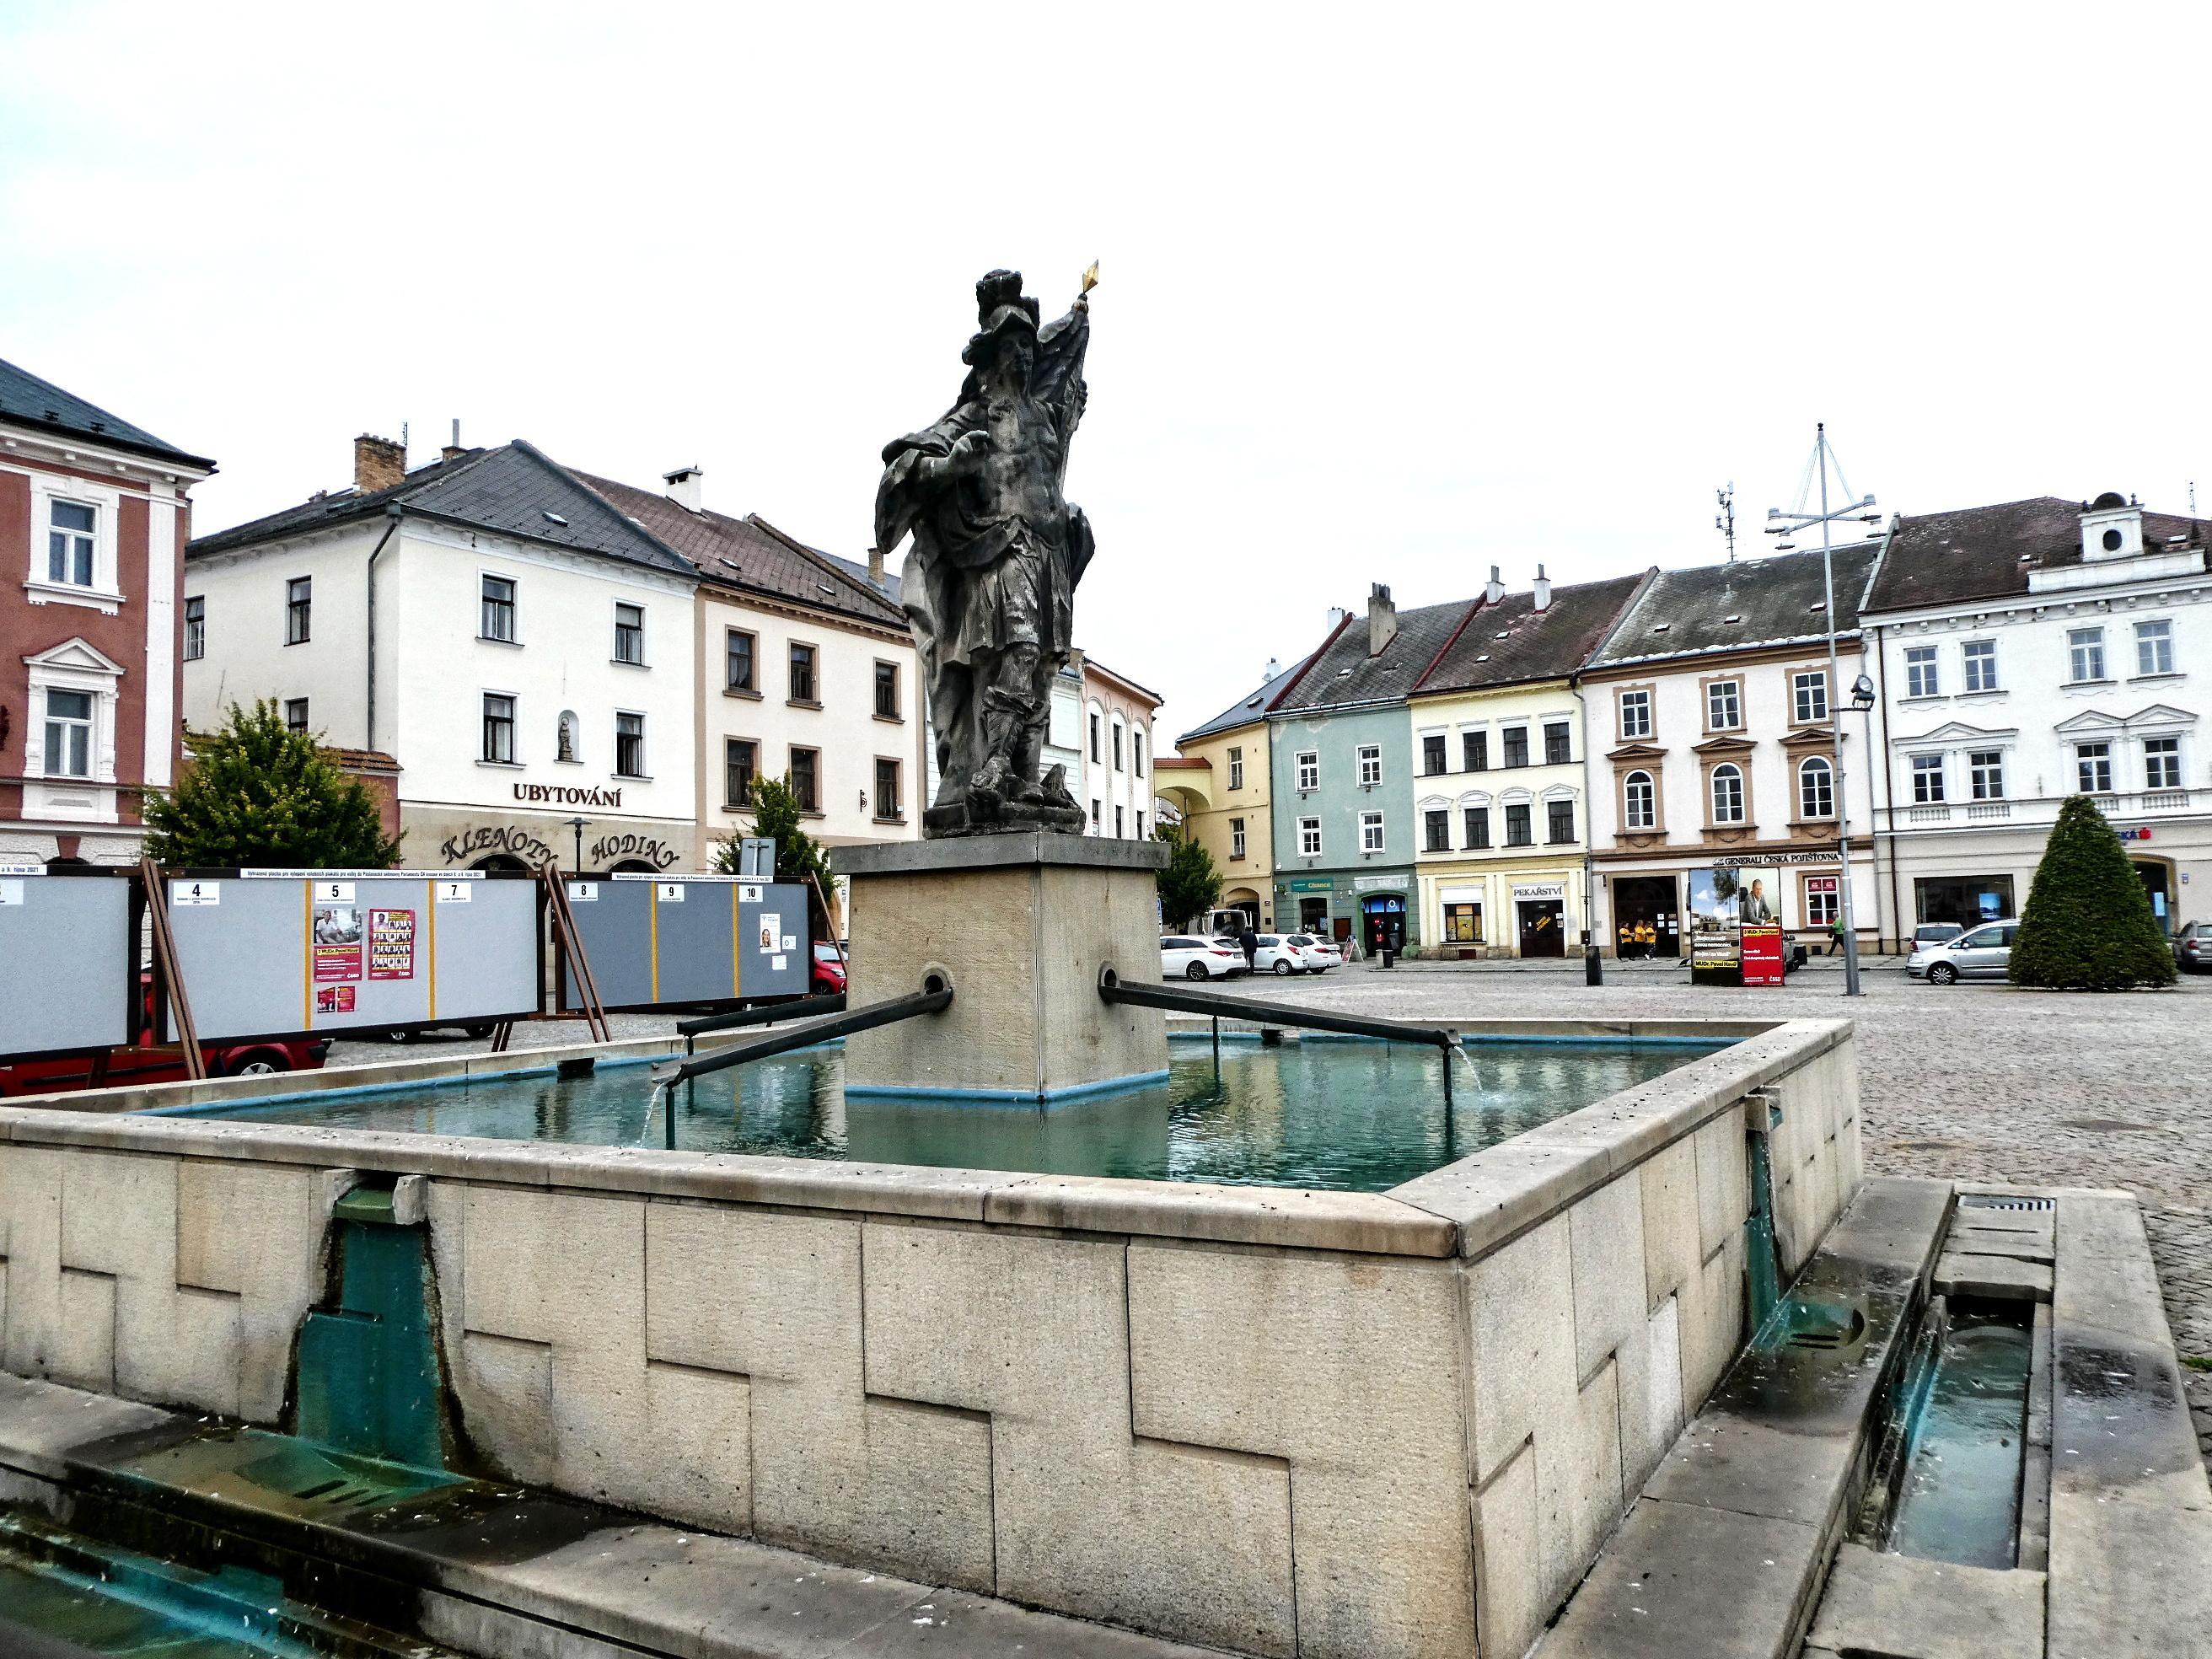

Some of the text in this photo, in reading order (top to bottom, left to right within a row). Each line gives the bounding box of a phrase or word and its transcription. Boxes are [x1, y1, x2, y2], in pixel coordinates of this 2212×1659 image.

[513, 782, 622, 808] UBYTOVÁNÍ
[441, 824, 559, 868] KLENOTY
[591, 834, 680, 869] HODINY
[1725, 852, 1839, 865] GENERALI ČESKÁ POJIŠŤOVNA
[192, 883, 201, 897] 4
[331, 885, 339, 898] 5
[451, 884, 458, 896] 7
[581, 884, 587, 896] 8
[668, 886, 674, 897] 9
[747, 888, 756, 898] 10
[1513, 885, 1563, 897] PEKAŘSTVÍ
